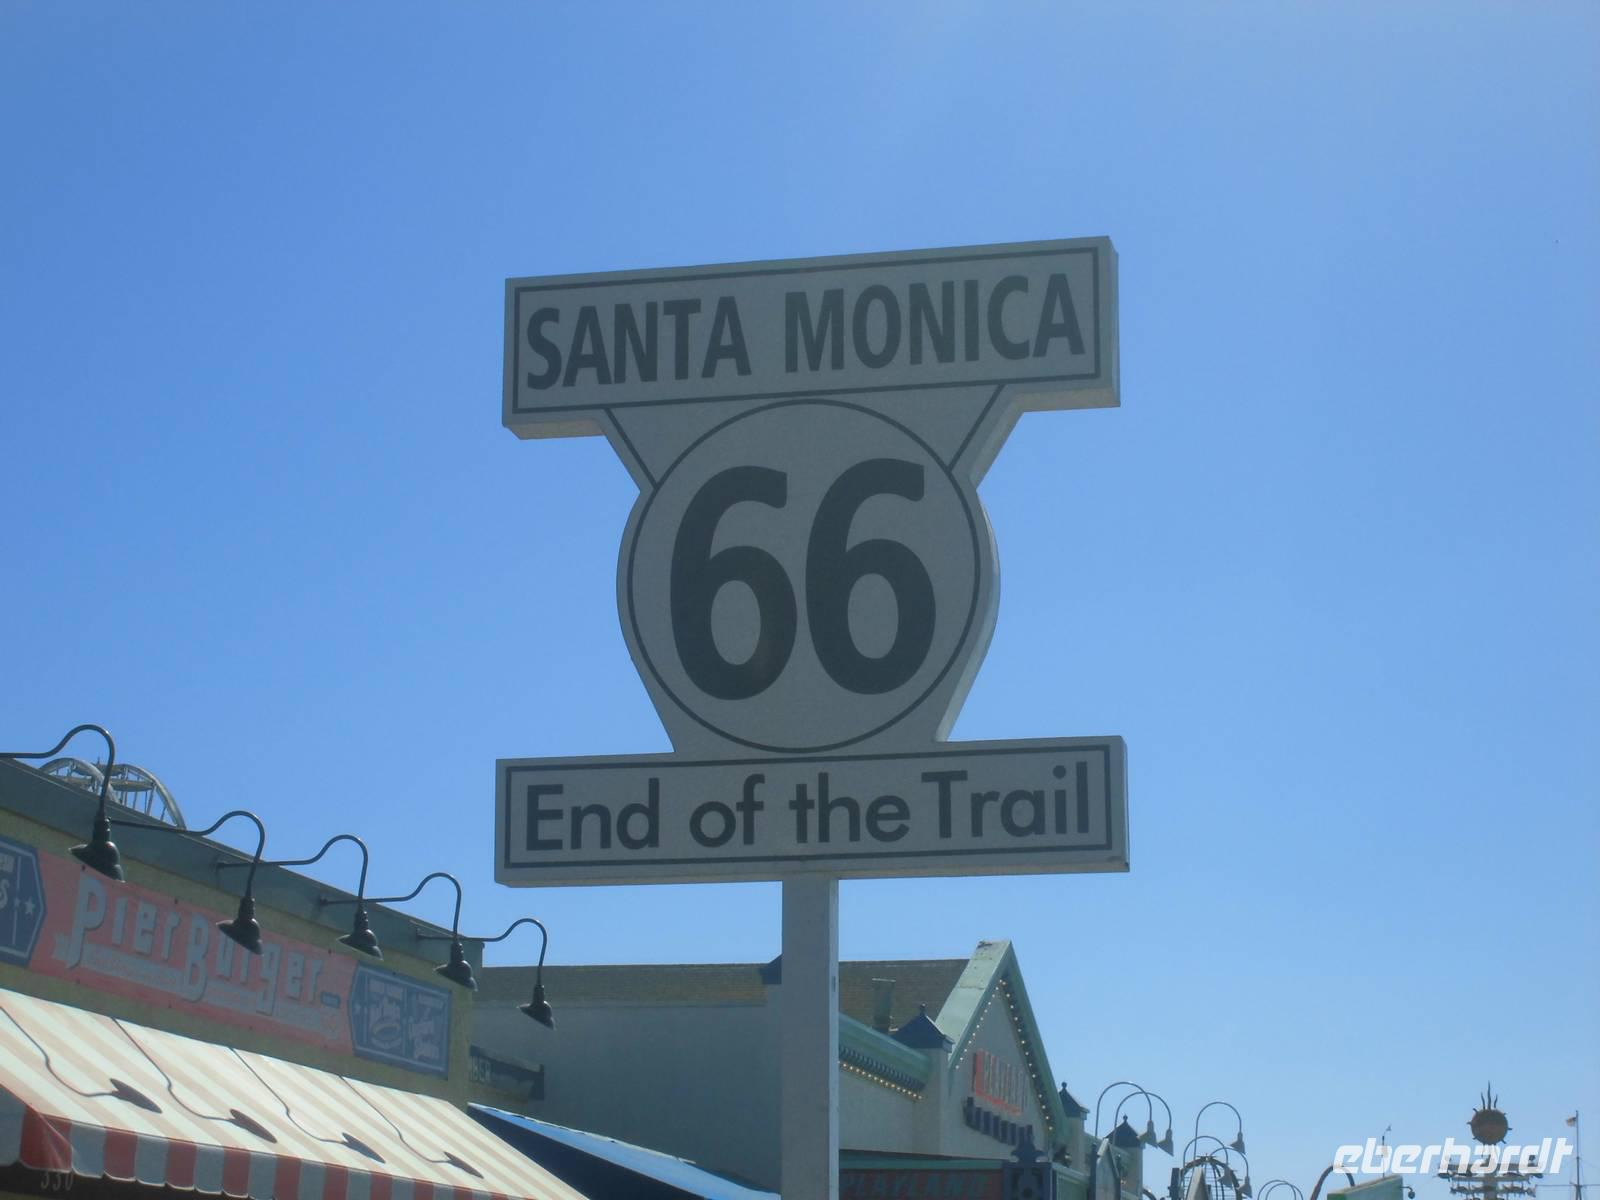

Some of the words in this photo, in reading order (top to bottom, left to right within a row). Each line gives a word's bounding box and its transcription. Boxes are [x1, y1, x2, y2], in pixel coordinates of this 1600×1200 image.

[525, 296, 752, 391] SANTA
[784, 272, 1086, 374] MONICA
[670, 457, 937, 701] 66
[525, 778, 660, 852] End
[689, 774, 765, 848] of
[789, 772, 910, 843] the
[921, 761, 1089, 840] Trail
